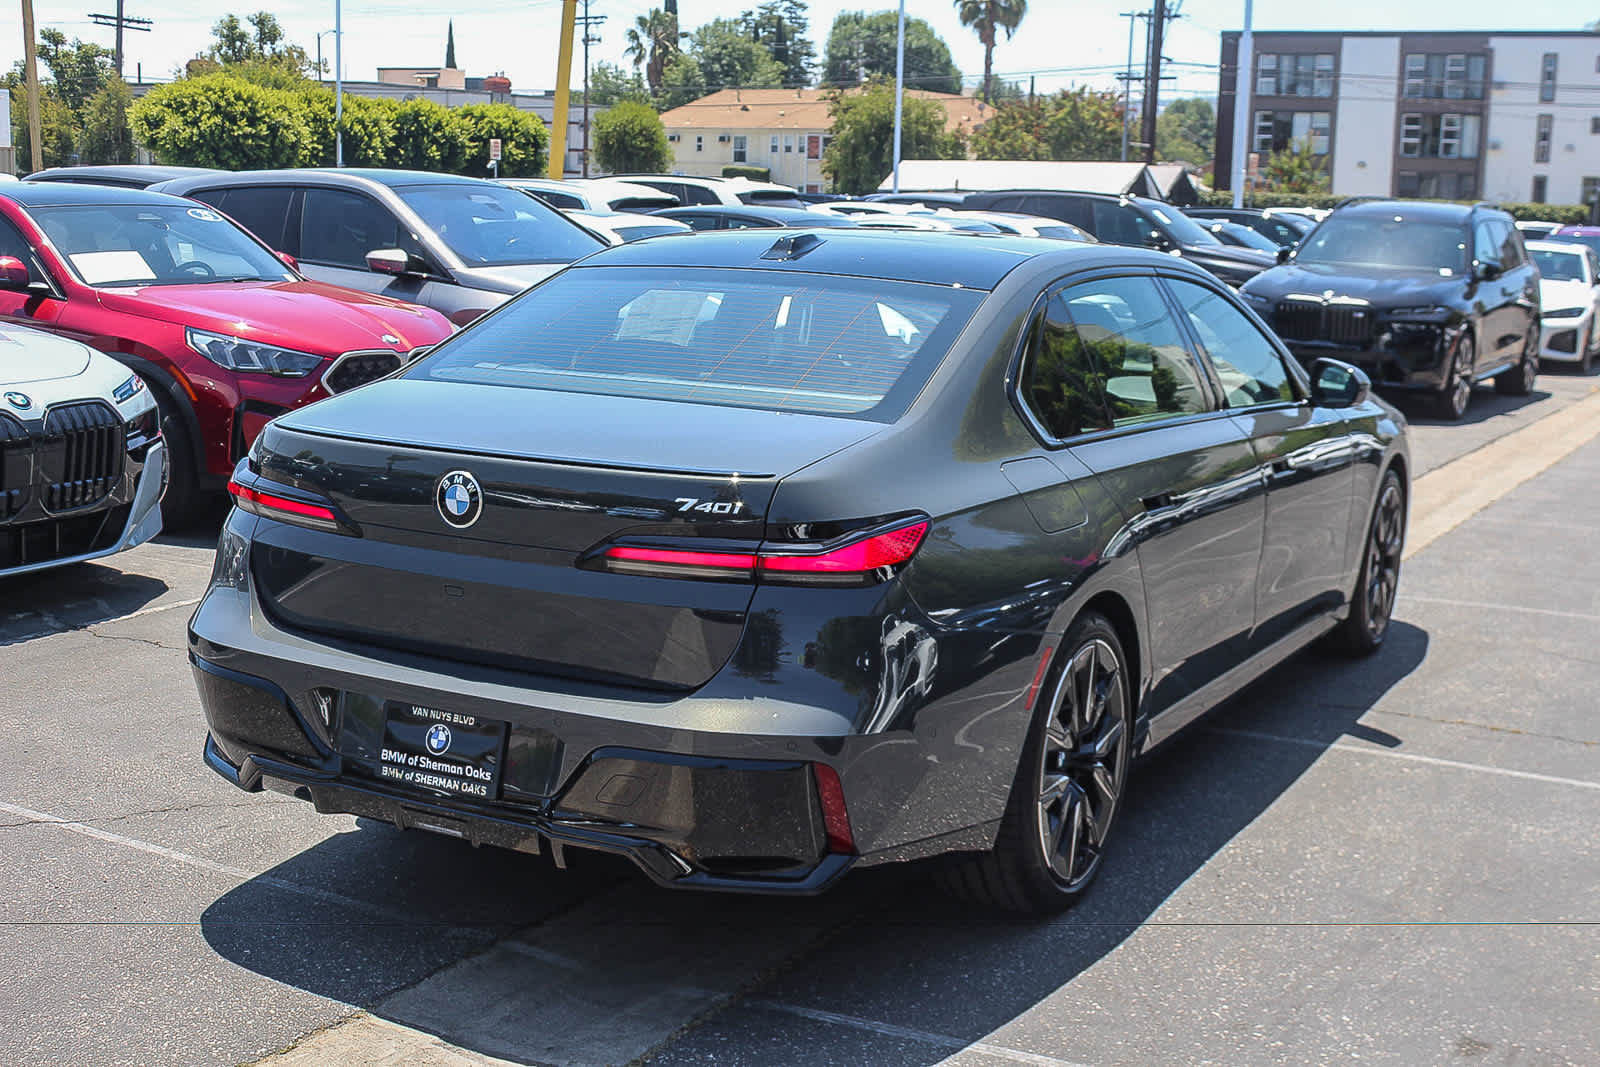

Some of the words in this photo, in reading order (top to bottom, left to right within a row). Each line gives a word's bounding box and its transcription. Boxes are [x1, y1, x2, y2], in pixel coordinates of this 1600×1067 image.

[674, 497, 743, 514] 740i
[411, 706, 429, 718] VAN
[429, 709, 452, 722] NUYS
[453, 714, 475, 726] BLVD
[381, 748, 407, 764] BMW
[408, 755, 419, 766] of
[419, 756, 463, 775] Sherman
[465, 765, 492, 781] Oaks
[382, 766, 404, 780] BMW
[404, 771, 414, 781] of
[414, 773, 460, 791] SHERMAN
[461, 782, 488, 796] OAKS
